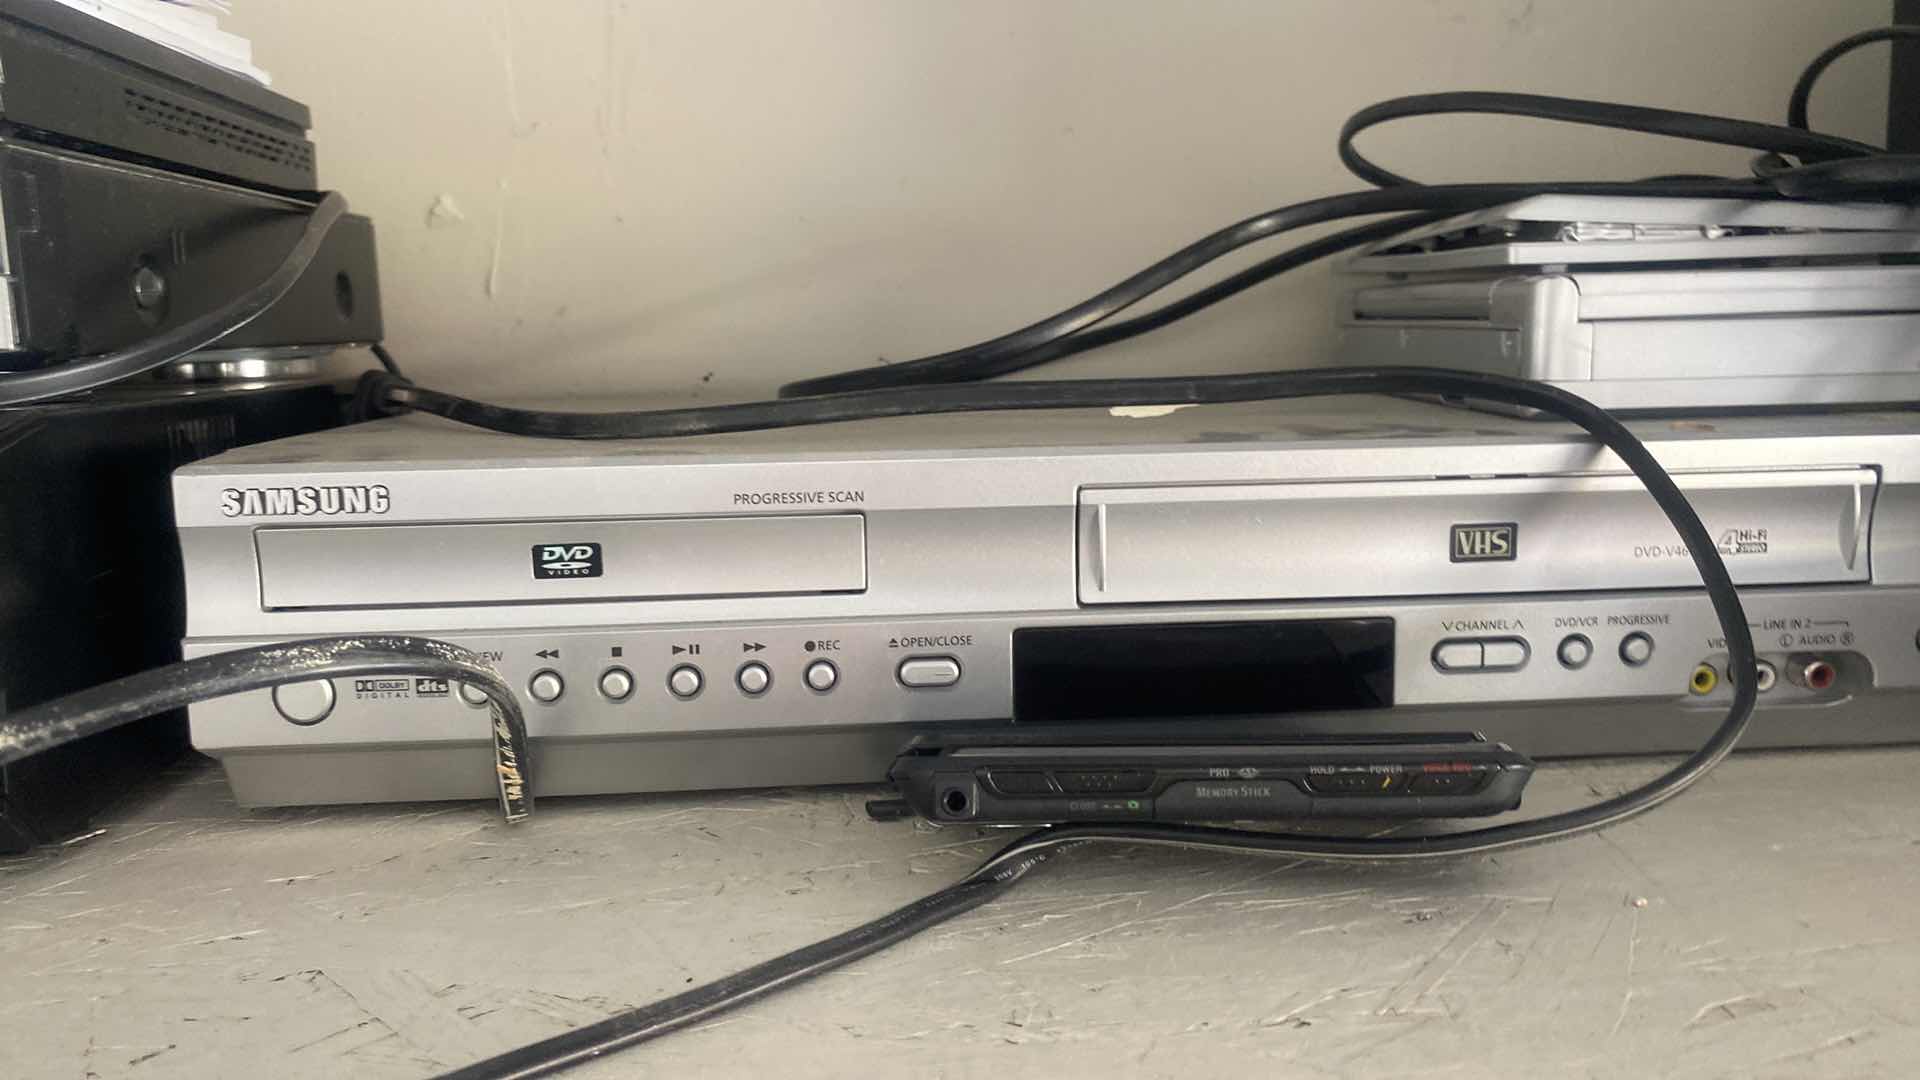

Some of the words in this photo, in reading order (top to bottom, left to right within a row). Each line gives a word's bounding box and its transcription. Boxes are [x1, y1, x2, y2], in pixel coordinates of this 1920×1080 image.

[220, 485, 390, 517] SAMSUNG
[733, 491, 825, 505] PROGRESSIVE
[828, 490, 865, 504] SCAN
[1459, 527, 1509, 555] VHS
[542, 545, 593, 561] DVD
[1634, 544, 1690, 559] DVD-V46
[548, 568, 590, 576] VIDEO
[1455, 619, 1509, 631] CHANNEL
[1554, 615, 1599, 628] DVD/VCR
[1607, 614, 1670, 626] PROGRESSIVE
[1763, 618, 1788, 631] LINE
[1790, 618, 1802, 630] IN
[817, 640, 841, 651] REC
[900, 634, 973, 648] OPEN/CLOSE
[1706, 637, 1728, 649] VID
[1799, 633, 1836, 646] AUDIO
[418, 679, 449, 693] dts
[355, 692, 410, 700] DIGITAL
